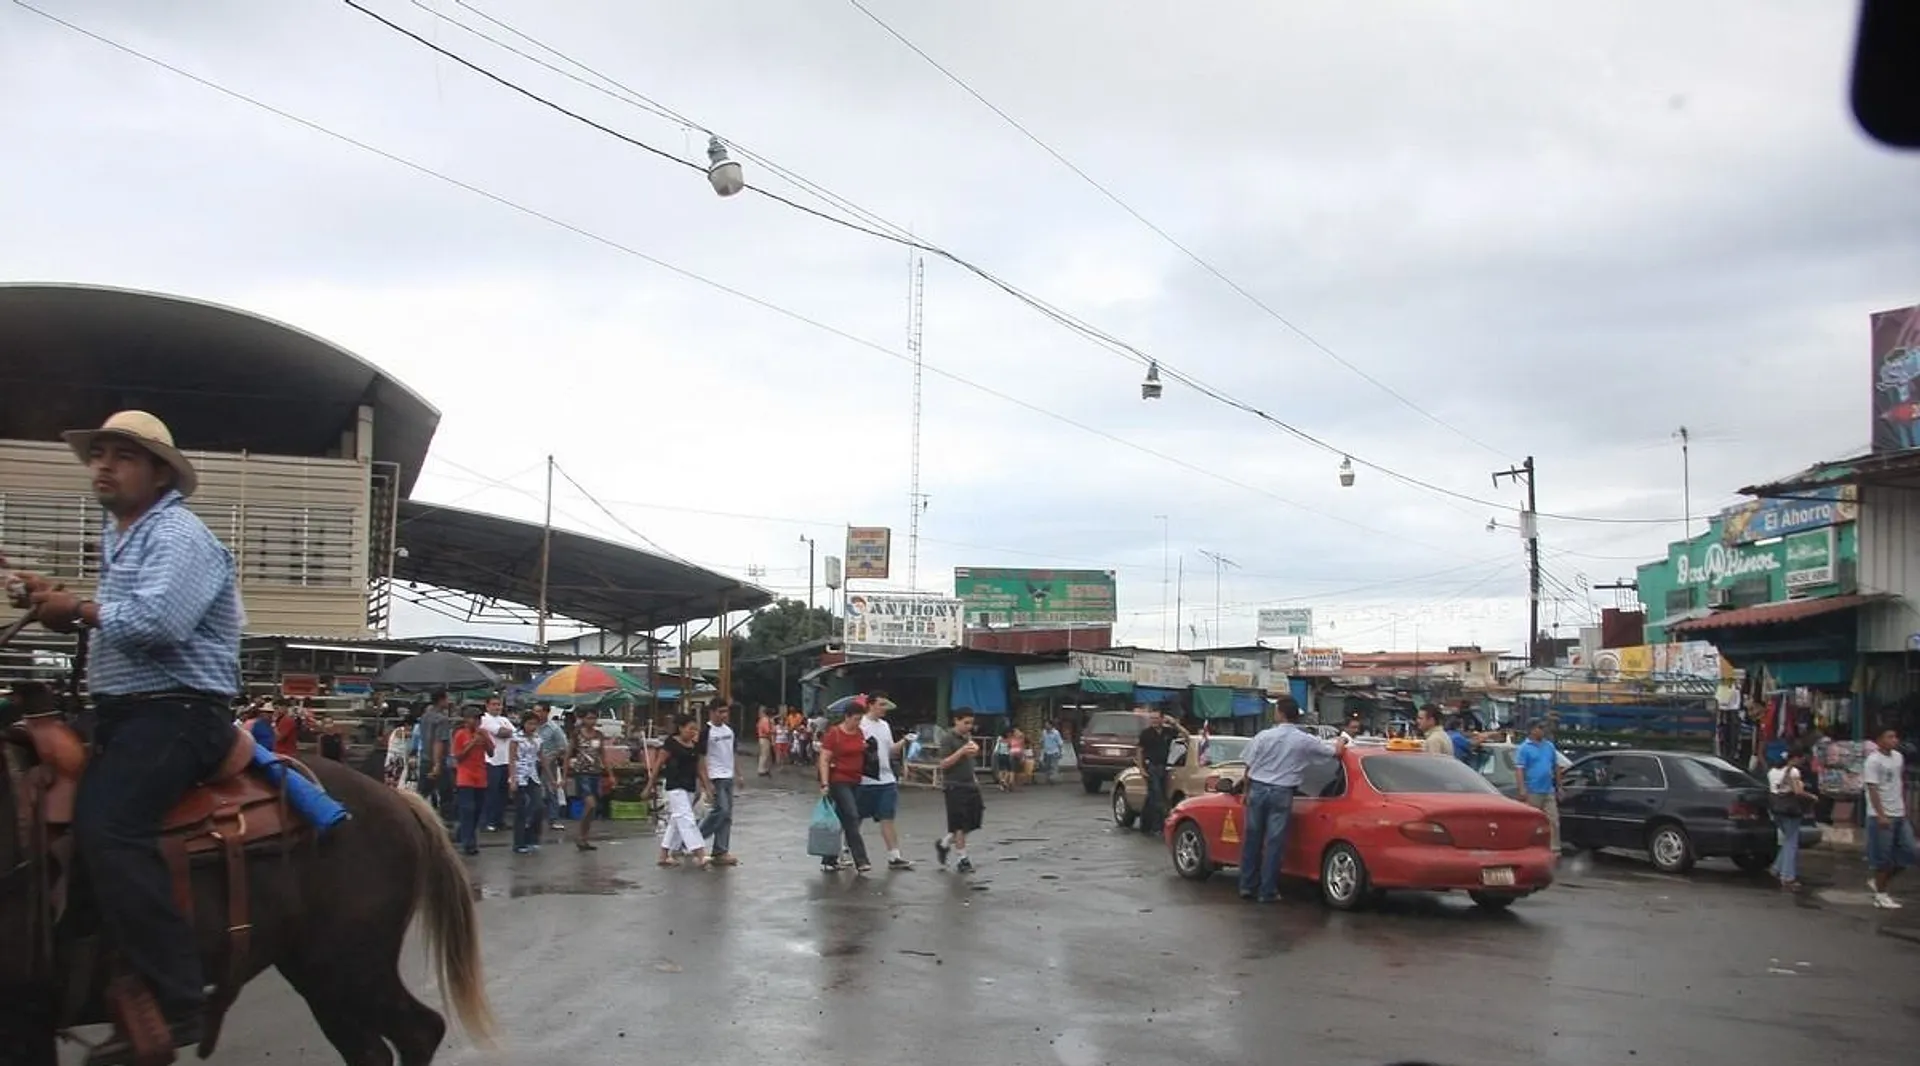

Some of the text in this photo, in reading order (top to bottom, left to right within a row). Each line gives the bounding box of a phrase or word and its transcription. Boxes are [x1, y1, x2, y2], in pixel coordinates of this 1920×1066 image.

[1765, 504, 1831, 531] El Ahorro
[869, 602, 960, 617] ANTHONY
